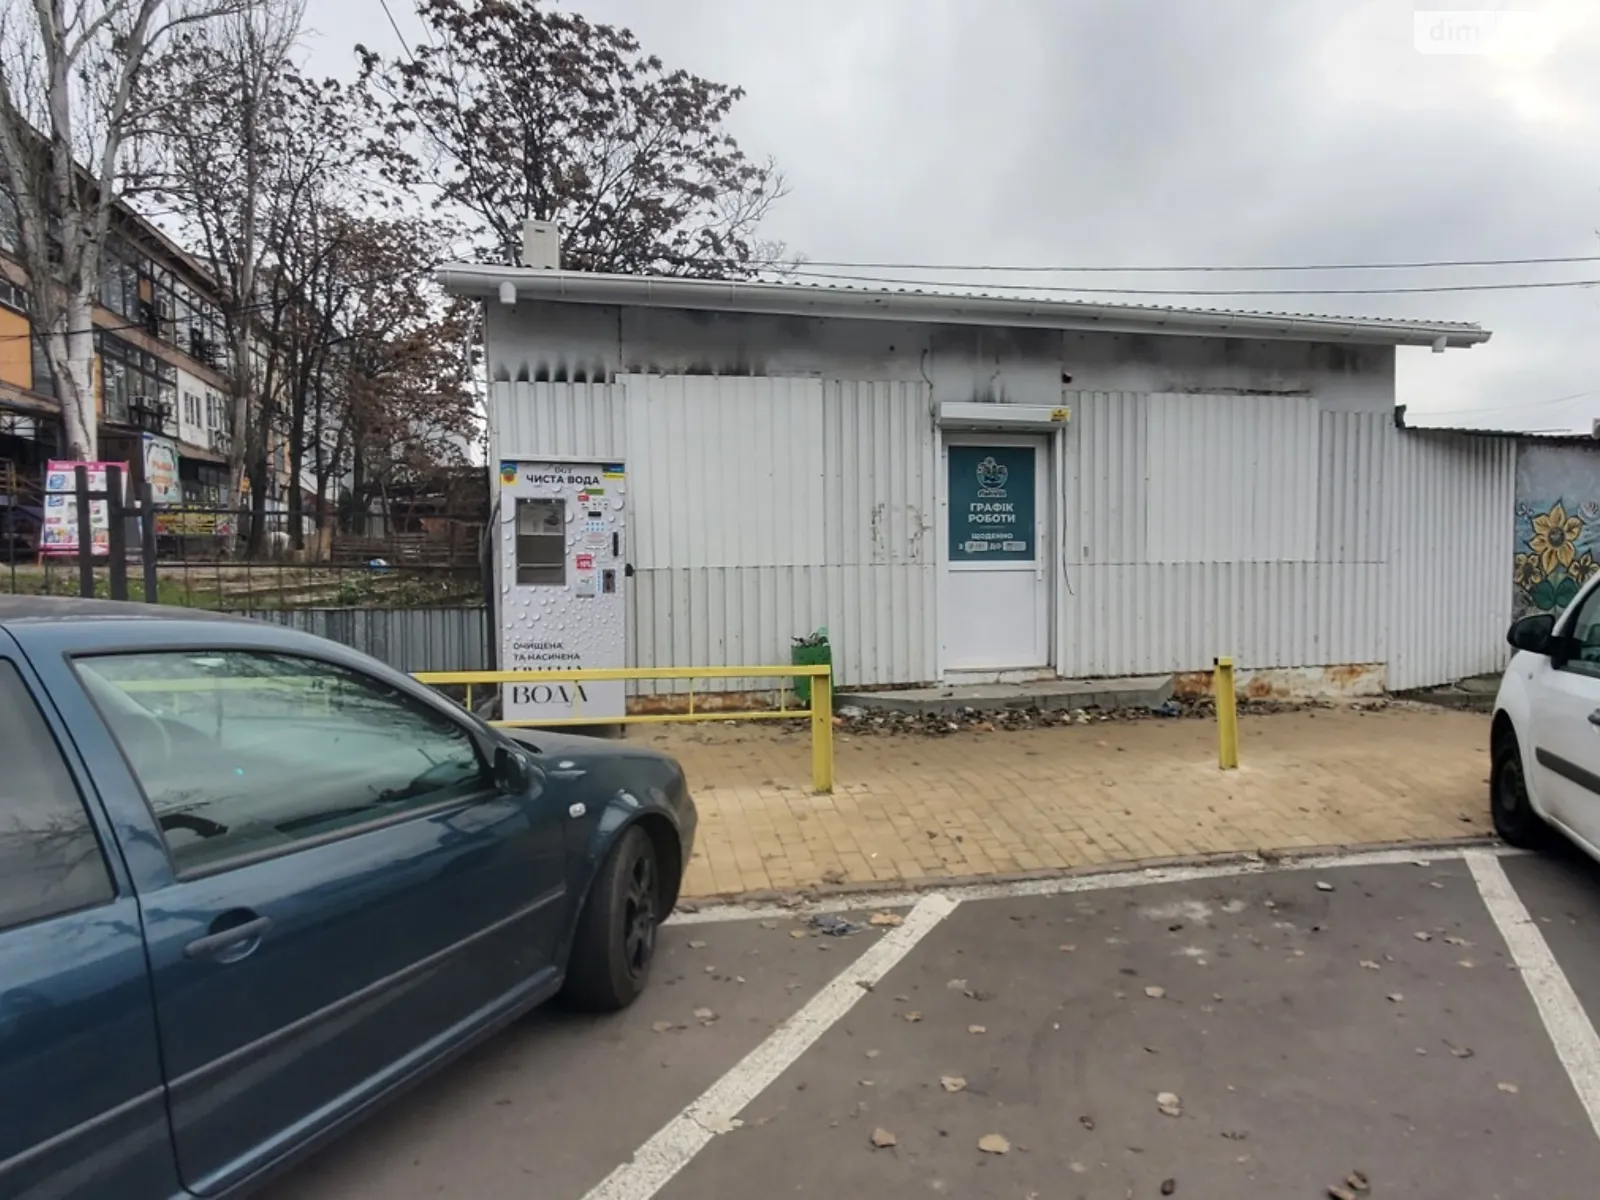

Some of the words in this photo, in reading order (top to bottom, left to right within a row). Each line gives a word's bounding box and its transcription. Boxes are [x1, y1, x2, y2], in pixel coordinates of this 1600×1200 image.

[526, 474, 565, 485] ЧИСТА
[568, 475, 600, 485] ВОДА
[970, 503, 1014, 512] ГРАФІК
[968, 514, 1016, 523] РОБОТИ
[513, 642, 563, 650] ОЧИЩЕНА
[513, 653, 526, 661] ТА
[527, 653, 580, 661] НАСИЧЕНА
